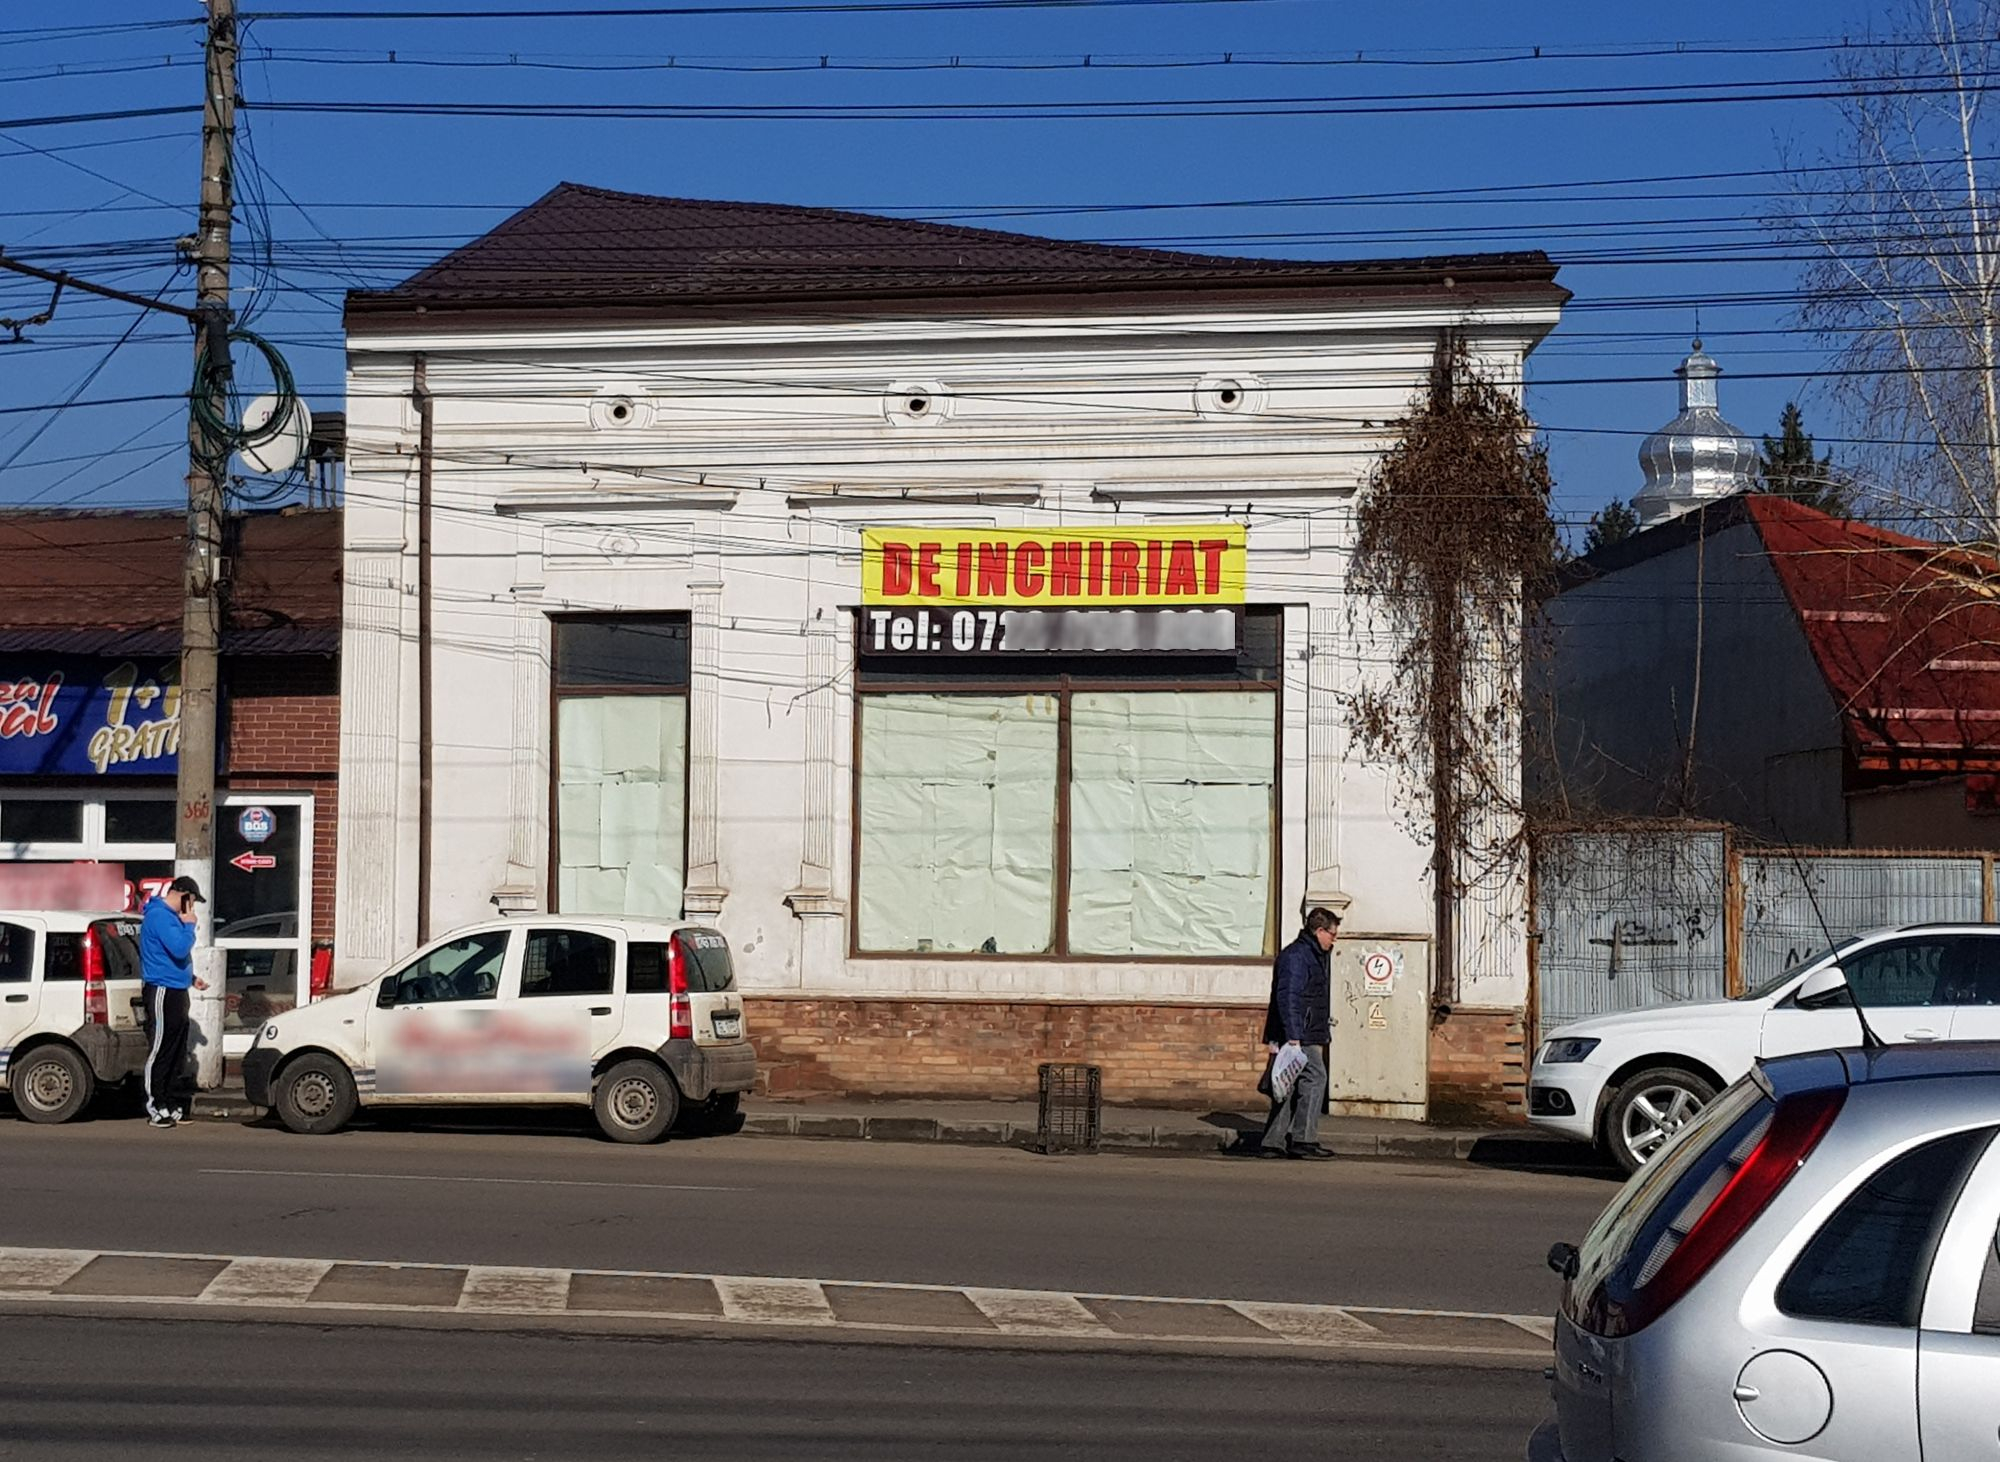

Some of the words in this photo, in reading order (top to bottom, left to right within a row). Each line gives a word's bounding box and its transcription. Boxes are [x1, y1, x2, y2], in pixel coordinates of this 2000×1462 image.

[882, 542, 942, 596] DE
[955, 539, 1229, 597] INCHIRIAT
[869, 610, 942, 651] Tel:
[88, 716, 180, 775] GRATI
